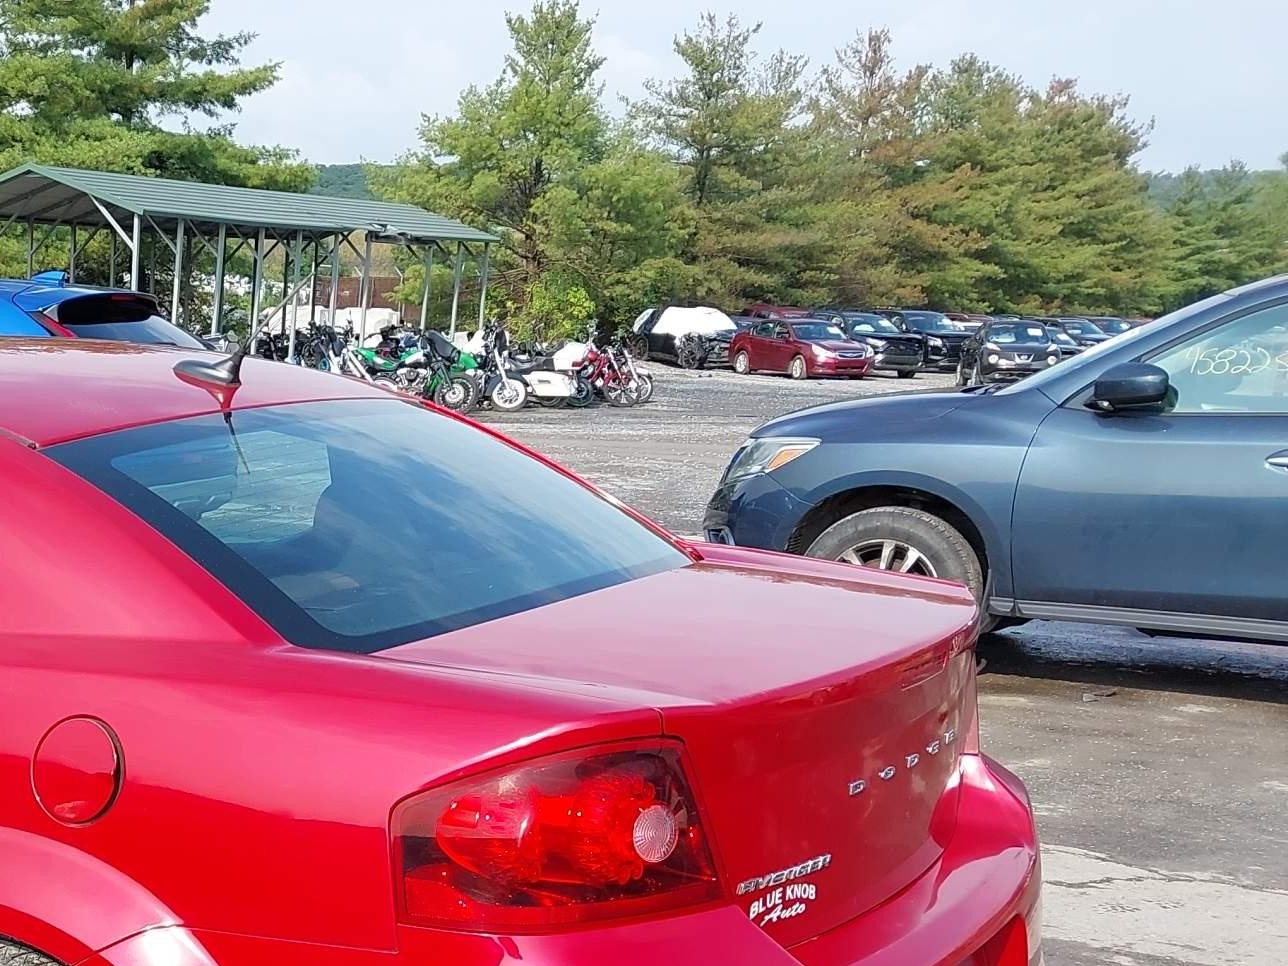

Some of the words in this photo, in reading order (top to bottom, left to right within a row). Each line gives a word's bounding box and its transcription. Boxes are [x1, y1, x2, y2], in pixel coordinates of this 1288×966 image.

[848, 729, 954, 796] DODGE
[736, 854, 831, 895] AVENGER
[749, 887, 783, 920] BLUE
[785, 884, 816, 900] KNOB
[759, 902, 805, 927] Auto
